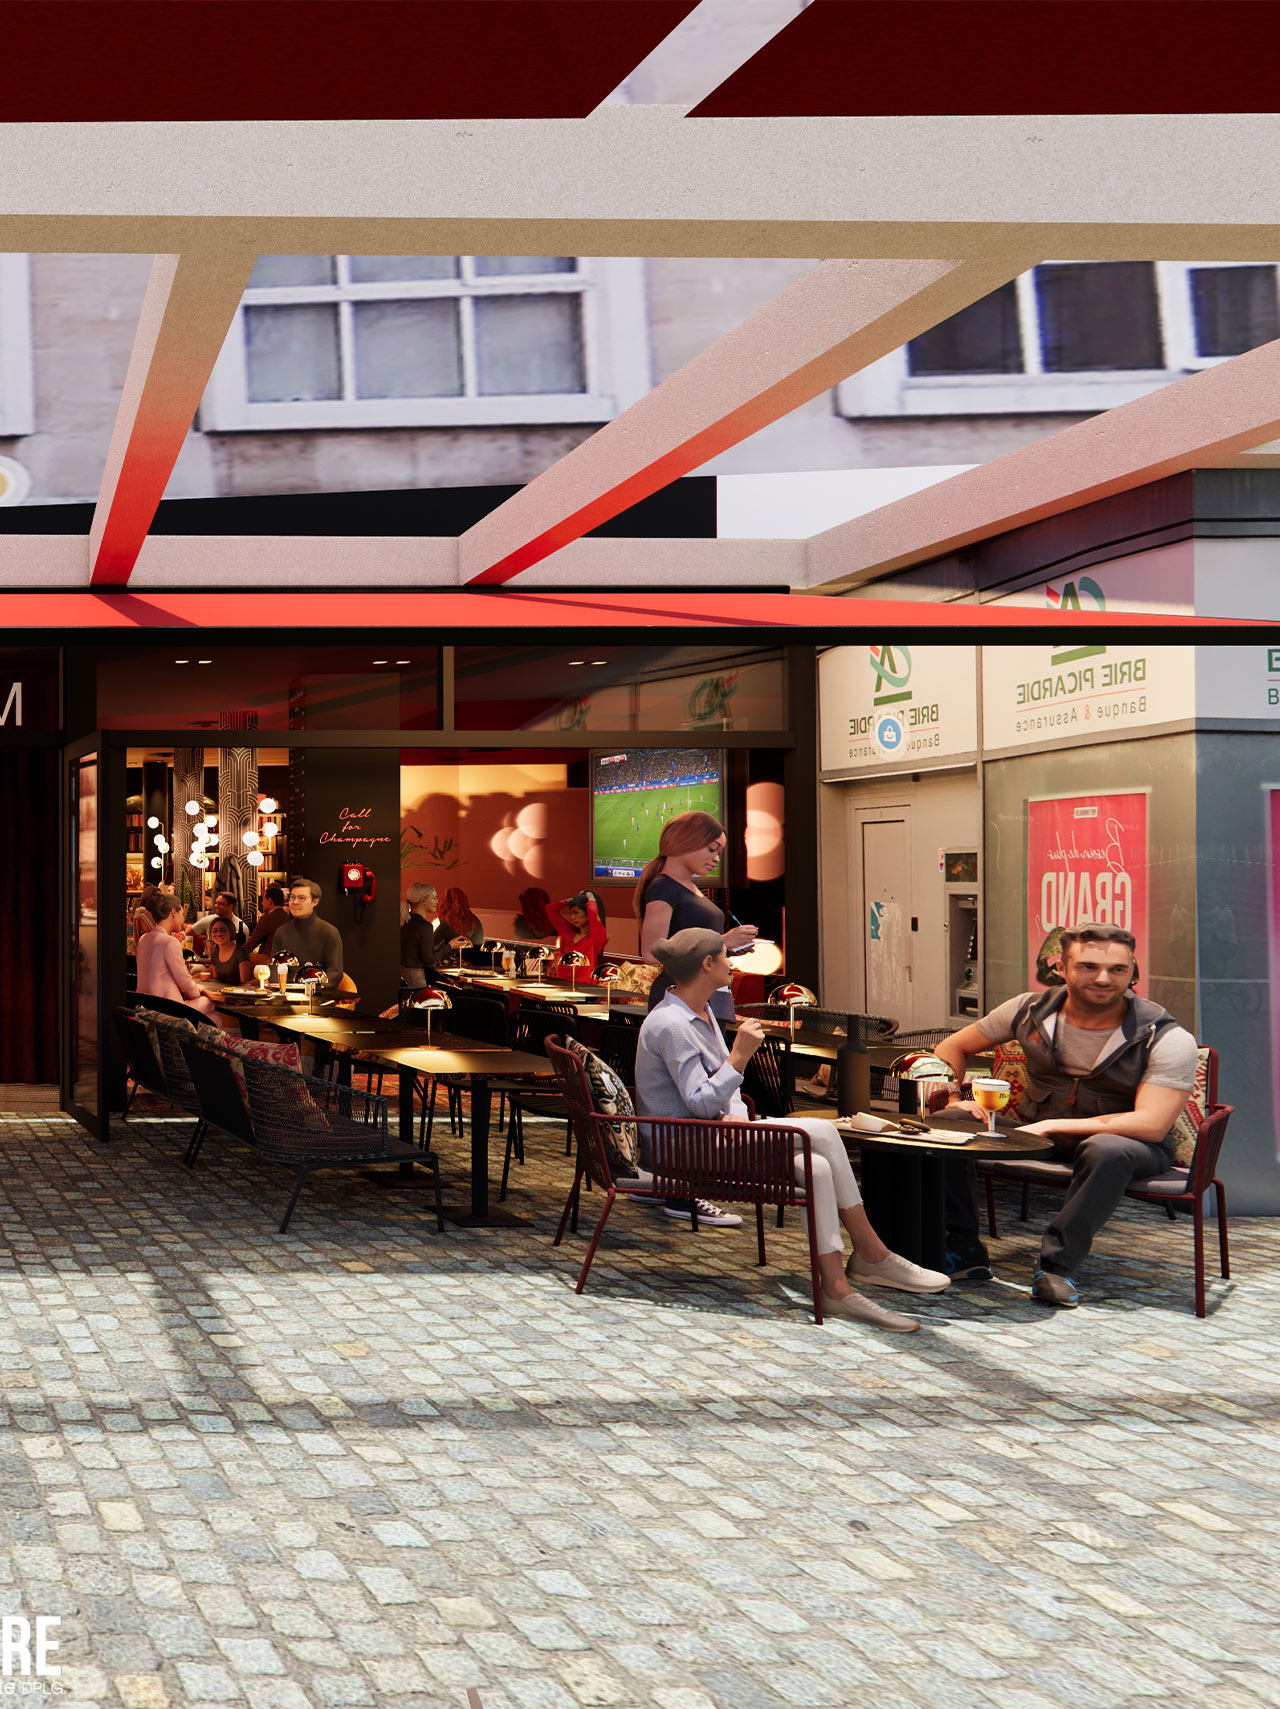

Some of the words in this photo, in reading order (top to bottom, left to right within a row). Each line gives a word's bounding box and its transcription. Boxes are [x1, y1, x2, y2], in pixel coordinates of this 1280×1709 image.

[339, 807, 372, 820] Call
[342, 820, 362, 833] for
[319, 831, 392, 848] Champagne
